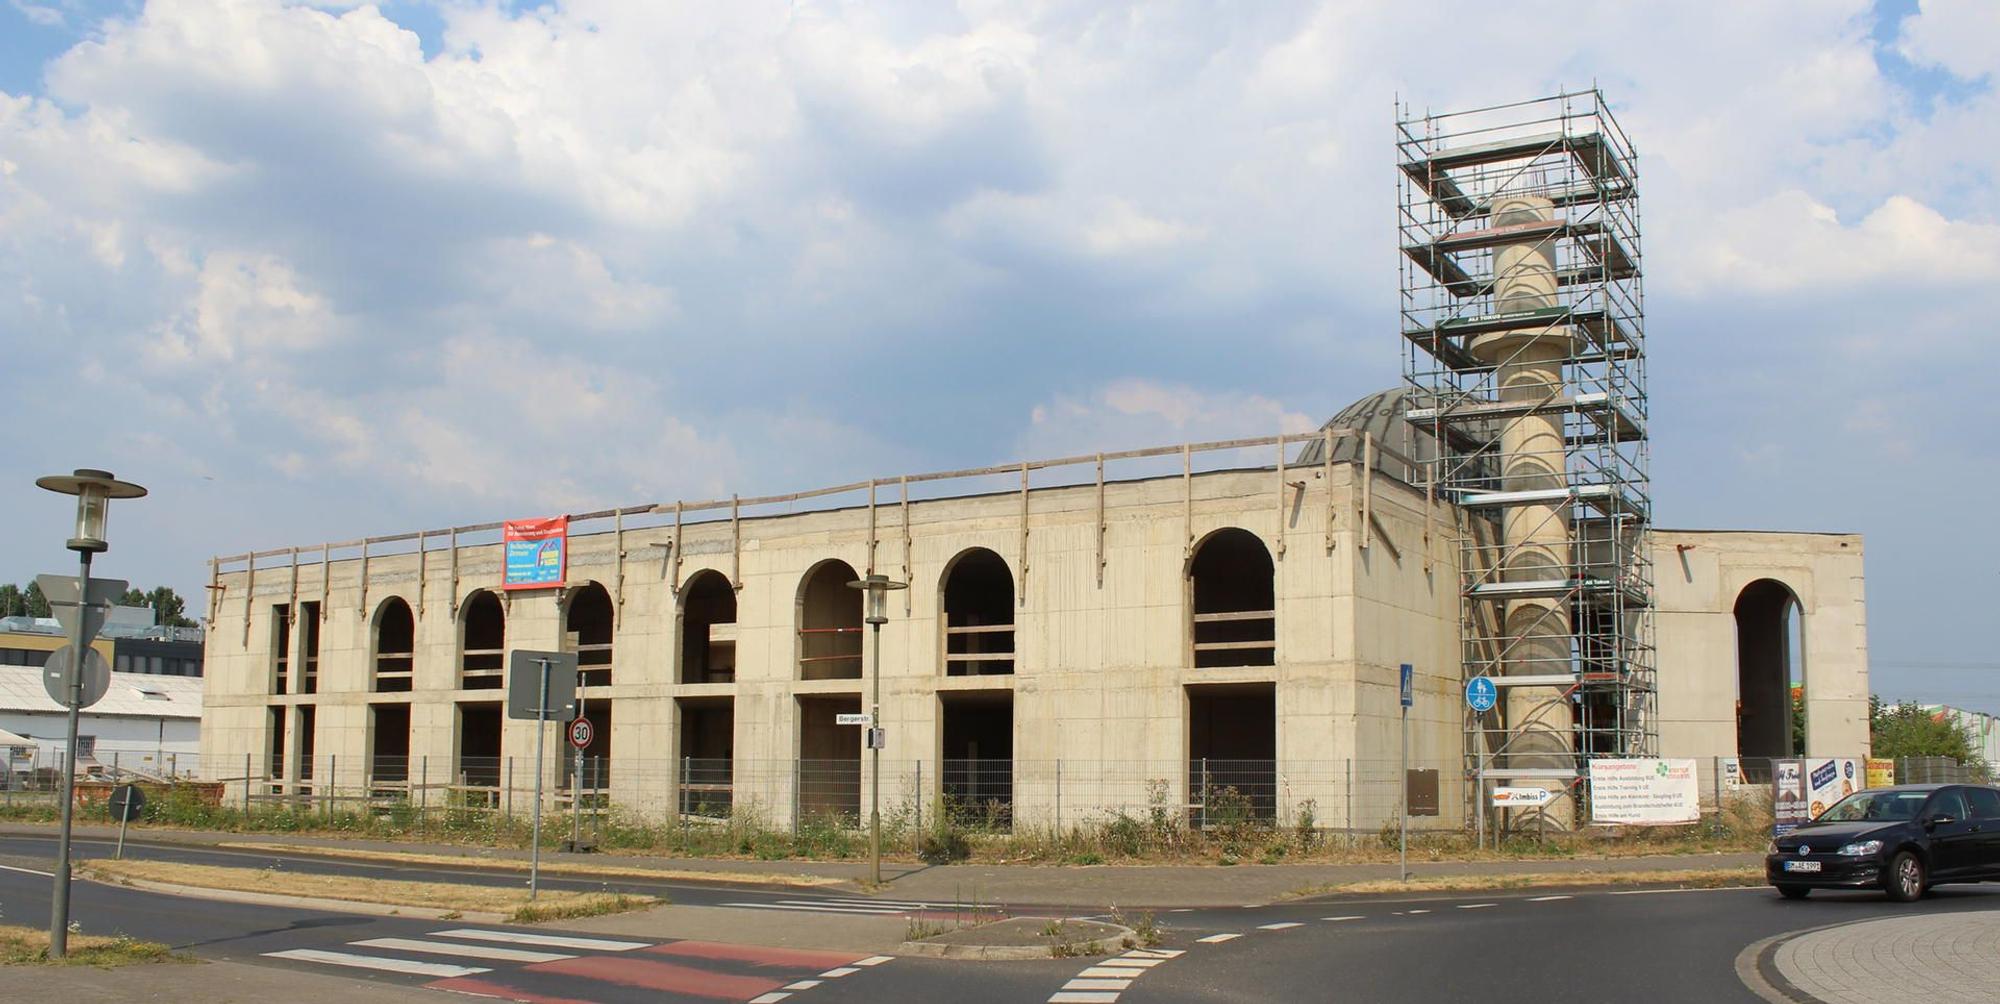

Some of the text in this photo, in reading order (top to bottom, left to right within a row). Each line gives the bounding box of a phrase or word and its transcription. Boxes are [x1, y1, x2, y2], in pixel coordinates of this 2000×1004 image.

[575, 726, 588, 740] 30
[1519, 791, 1546, 801] Imbiss P
